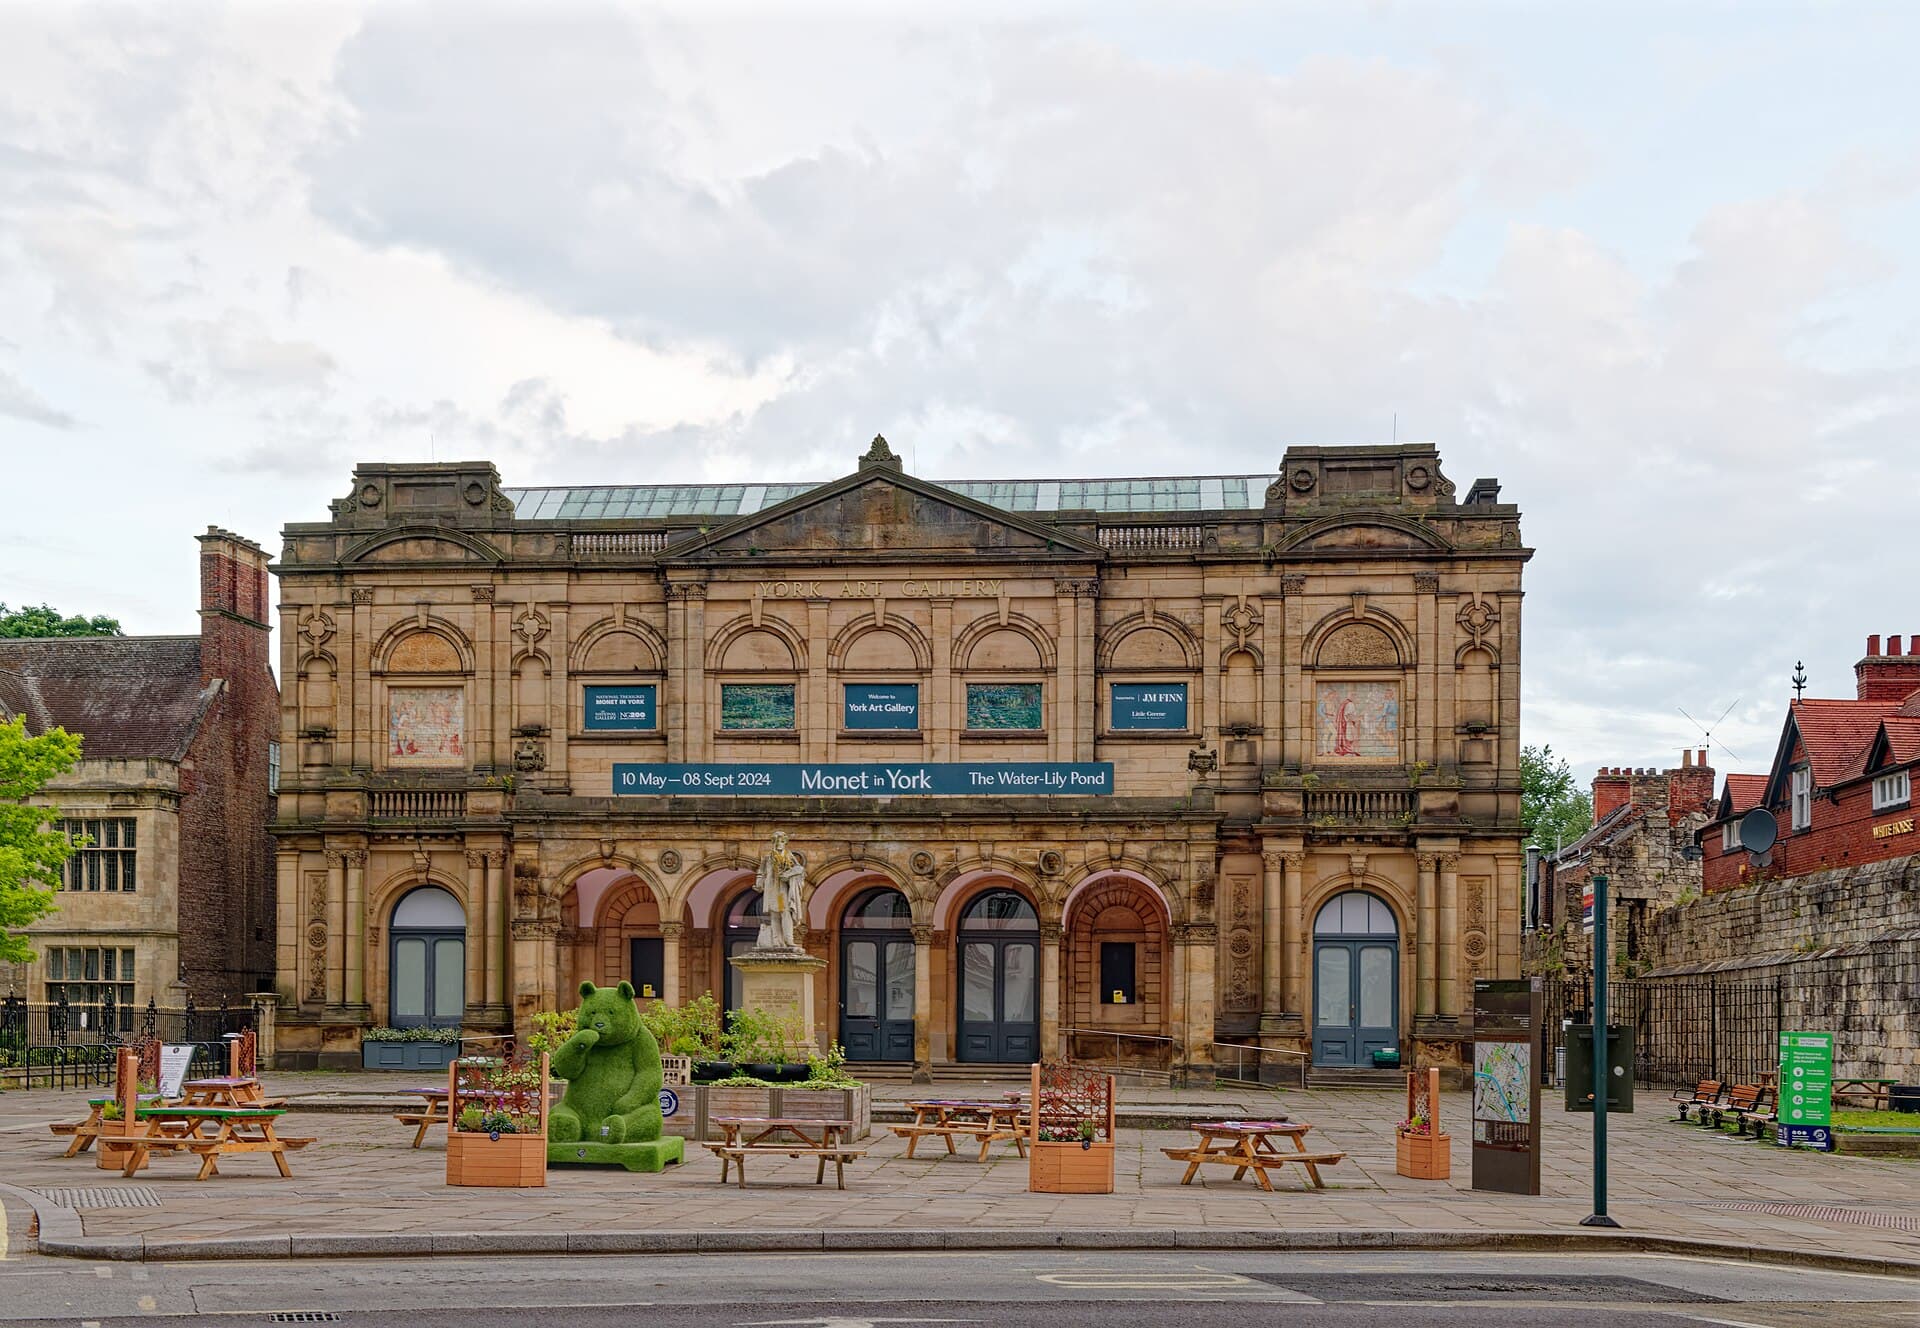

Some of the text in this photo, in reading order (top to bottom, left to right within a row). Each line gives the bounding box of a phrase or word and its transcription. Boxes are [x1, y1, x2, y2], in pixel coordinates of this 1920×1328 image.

[759, 580, 1001, 598] YORK ART GALLERY
[1142, 693, 1183, 702] JM FINN
[849, 703, 915, 714] York Art Gallery
[622, 772, 636, 786] 10
[704, 772, 735, 789] Sept
[737, 772, 772, 786] 2024
[801, 769, 932, 790] Monet in York
[968, 771, 1105, 788] The Water-Lily Pond
